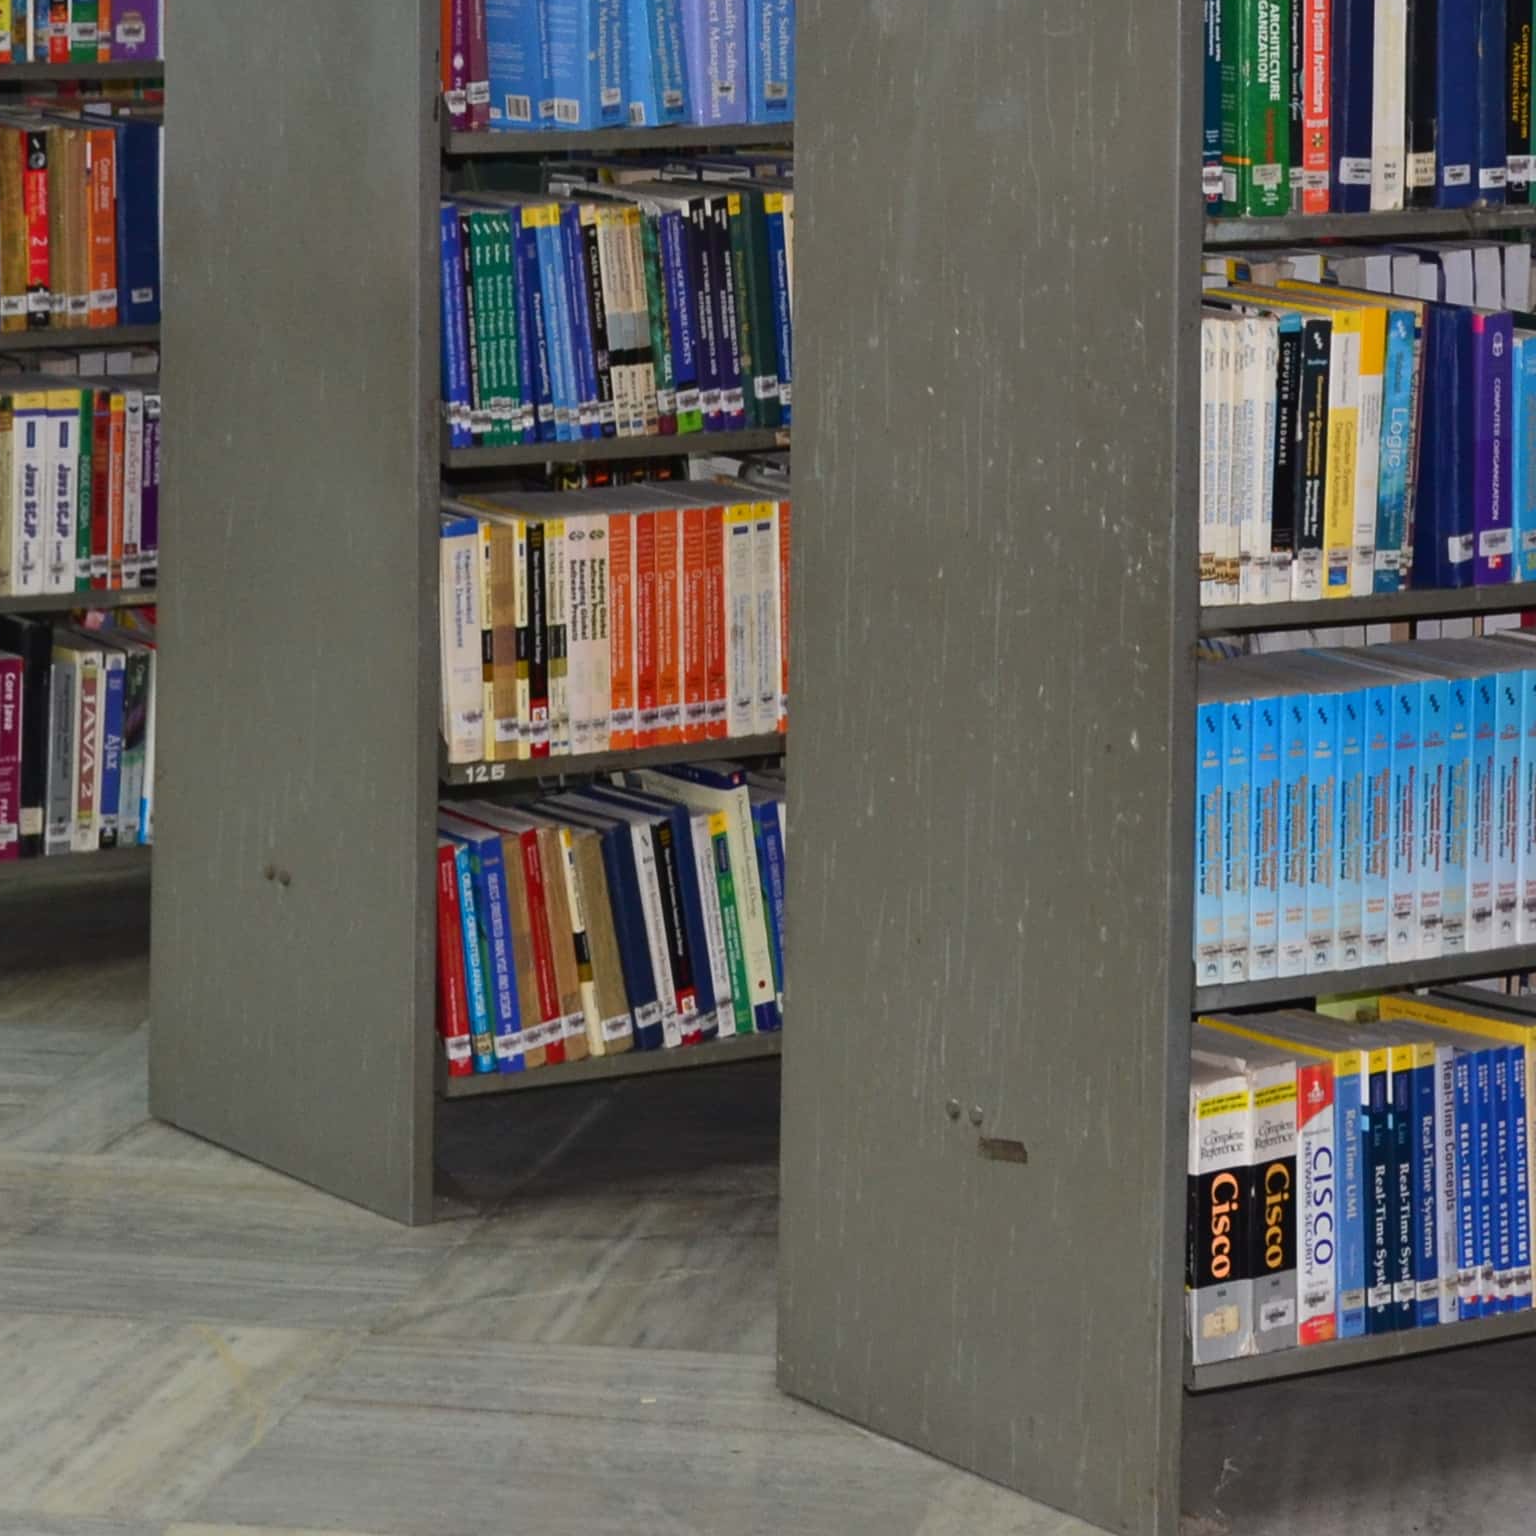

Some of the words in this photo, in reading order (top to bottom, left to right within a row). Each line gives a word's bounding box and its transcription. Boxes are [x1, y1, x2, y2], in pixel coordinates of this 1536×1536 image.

[779, 18, 790, 80] Software
[1269, 3, 1280, 101] ARCHITECTURE
[1521, 24, 1529, 88] Computer
[1512, 42, 1520, 122] Architecture
[1520, 92, 1528, 139] System
[1281, 341, 1291, 400] COMPUTER
[1278, 407, 1288, 466] HARDWARE
[1387, 407, 1409, 469] Logic
[1492, 377, 1502, 441] COMPUTER
[1490, 445, 1501, 521] ORGANIZATION
[82, 691, 96, 773] JAVA
[104, 734, 121, 770] Ajax
[81, 784, 92, 798] 2
[1444, 1061, 1455, 1137] Real-Time
[1200, 1143, 1244, 1160] Reference
[1204, 1131, 1245, 1146] Complete
[1422, 1116, 1434, 1191] Real-Time
[1304, 1142, 1313, 1211] NETWORK
[1313, 1147, 1333, 1265] CISCO
[1443, 1142, 1455, 1212] Concepts
[1211, 1172, 1239, 1279] Cisco
[1265, 1163, 1289, 1269] Cisco
[1304, 1215, 1313, 1275] SECURITY
[1422, 1196, 1434, 1259] Systems
